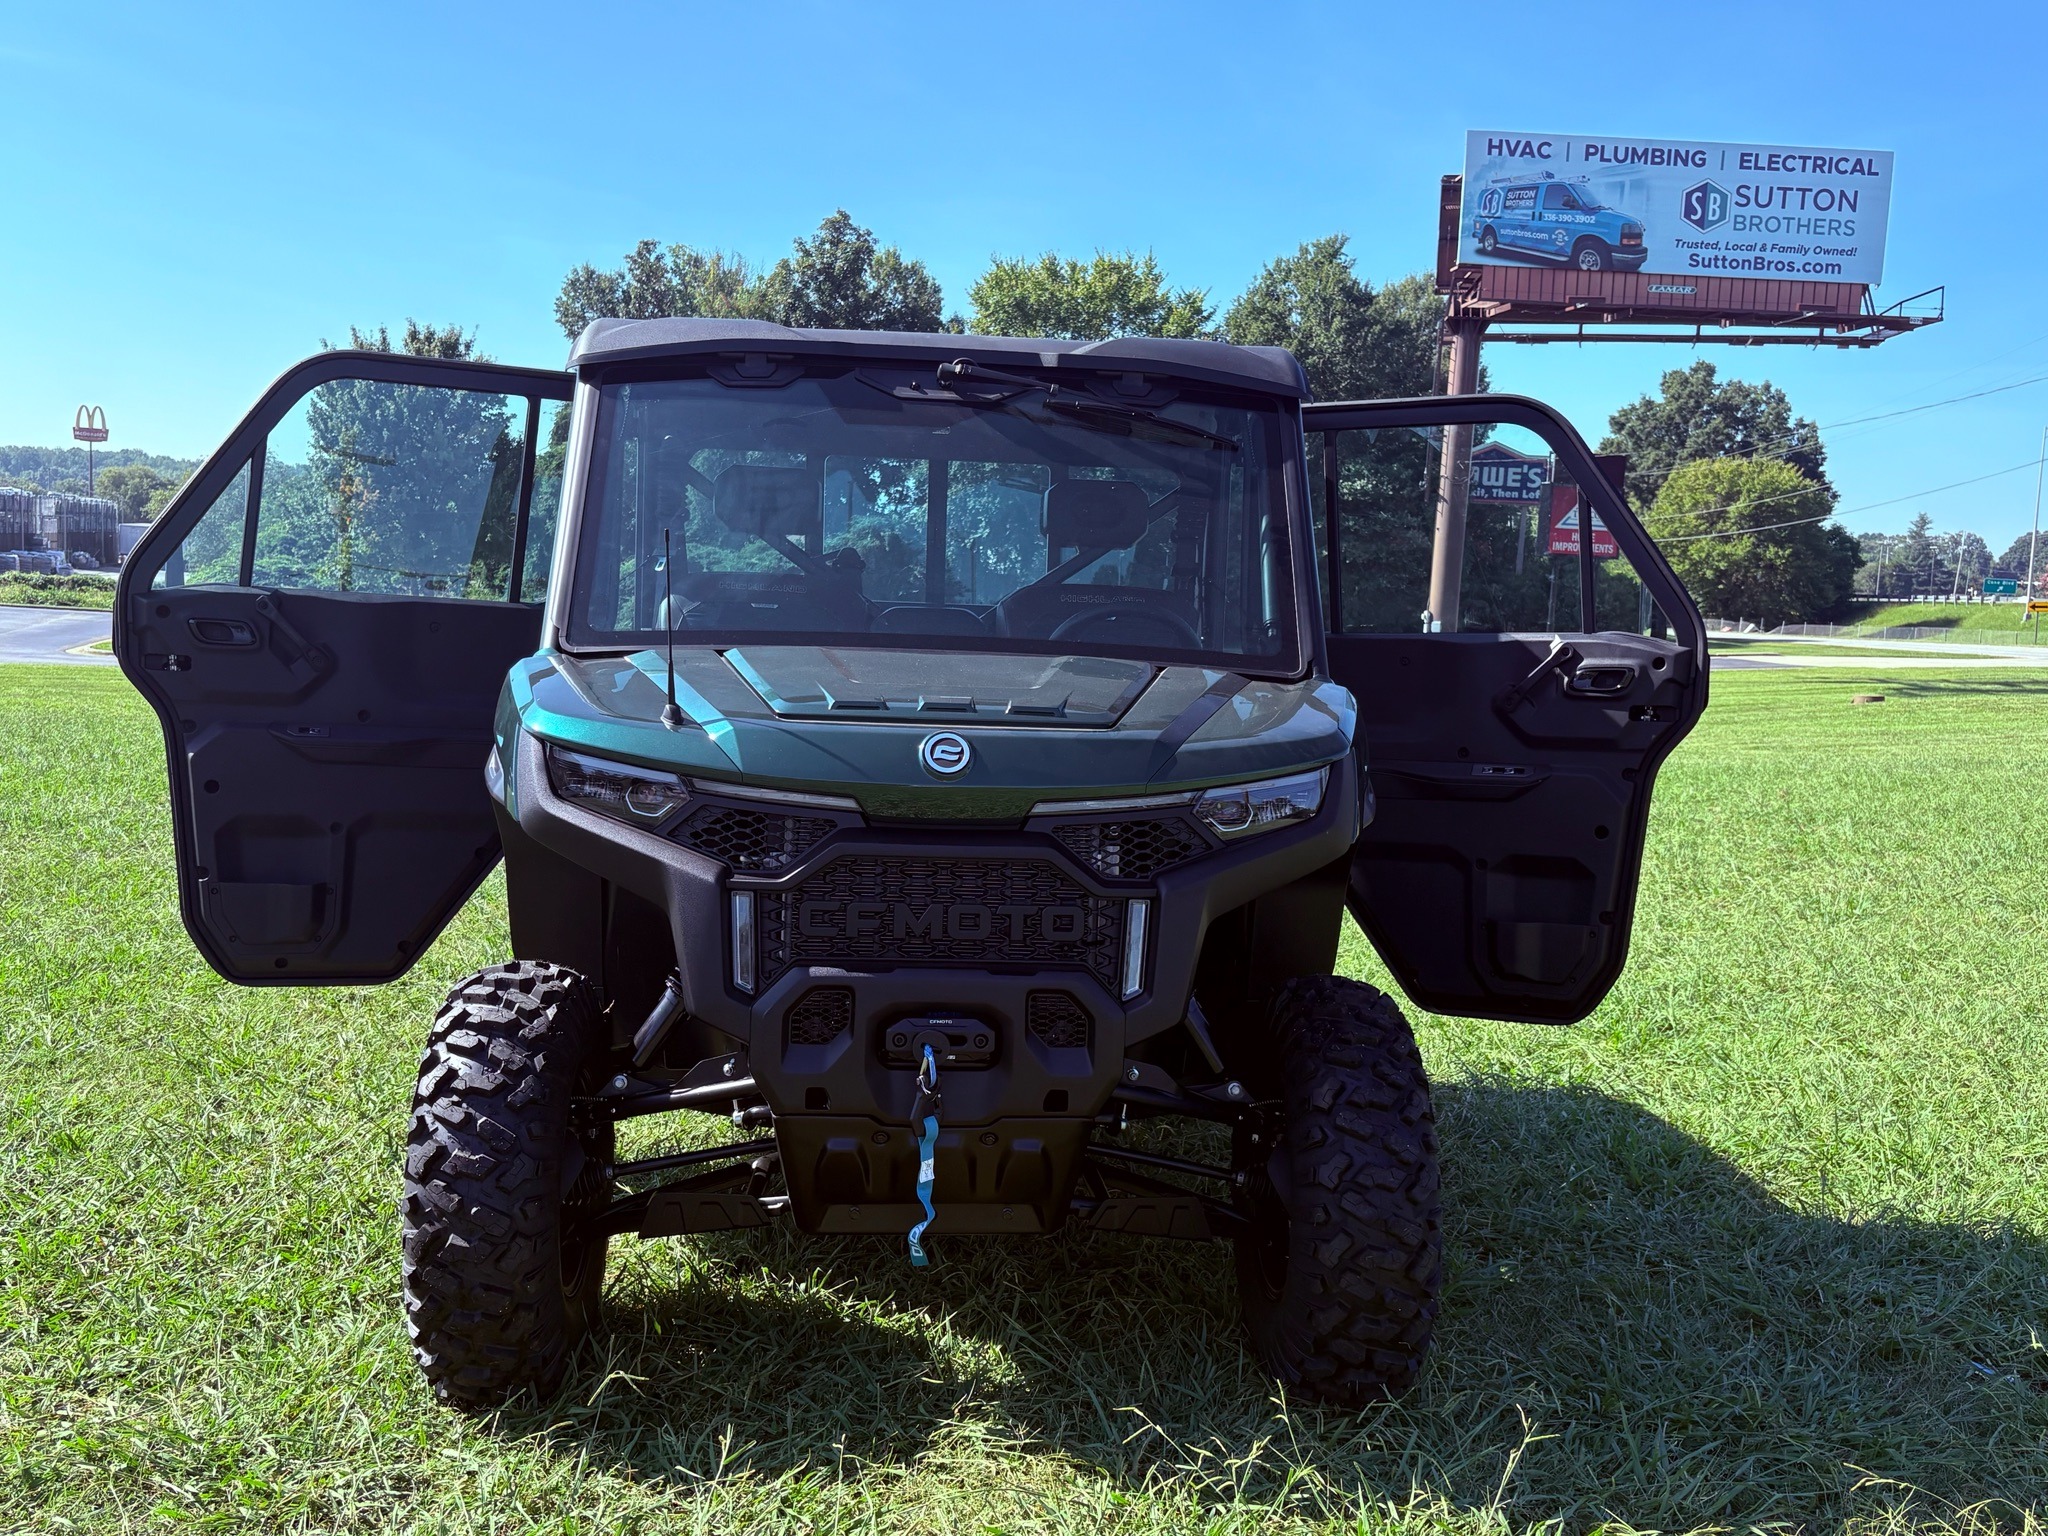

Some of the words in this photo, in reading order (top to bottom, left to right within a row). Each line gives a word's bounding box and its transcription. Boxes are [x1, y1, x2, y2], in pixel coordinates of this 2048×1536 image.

[1487, 138, 1553, 160] HVAC
[1584, 143, 1707, 169] PLUMBING
[1739, 152, 1880, 177] ELECTRICAL
[1507, 189, 1537, 200] SUTTON
[1734, 184, 1859, 213] SUTTON
[1506, 199, 1535, 208] BROTHERS
[1544, 213, 1596, 225] 336-390-3902
[1733, 214, 1856, 237] BROTHERS
[1500, 228, 1549, 241] suttonbros.com
[1675, 239, 1722, 252] Trusted,
[1725, 241, 1757, 252] Local
[1759, 243, 1768, 253] &
[1770, 243, 1810, 257] Family
[1813, 246, 1858, 257] Owned!
[1688, 253, 1842, 275] SuttonBros.com
[1492, 488, 1519, 498] Then
[1522, 489, 1541, 499] Lef
[719, 581, 808, 594] HIGHLAND
[799, 901, 1086, 942] CFMOTO
